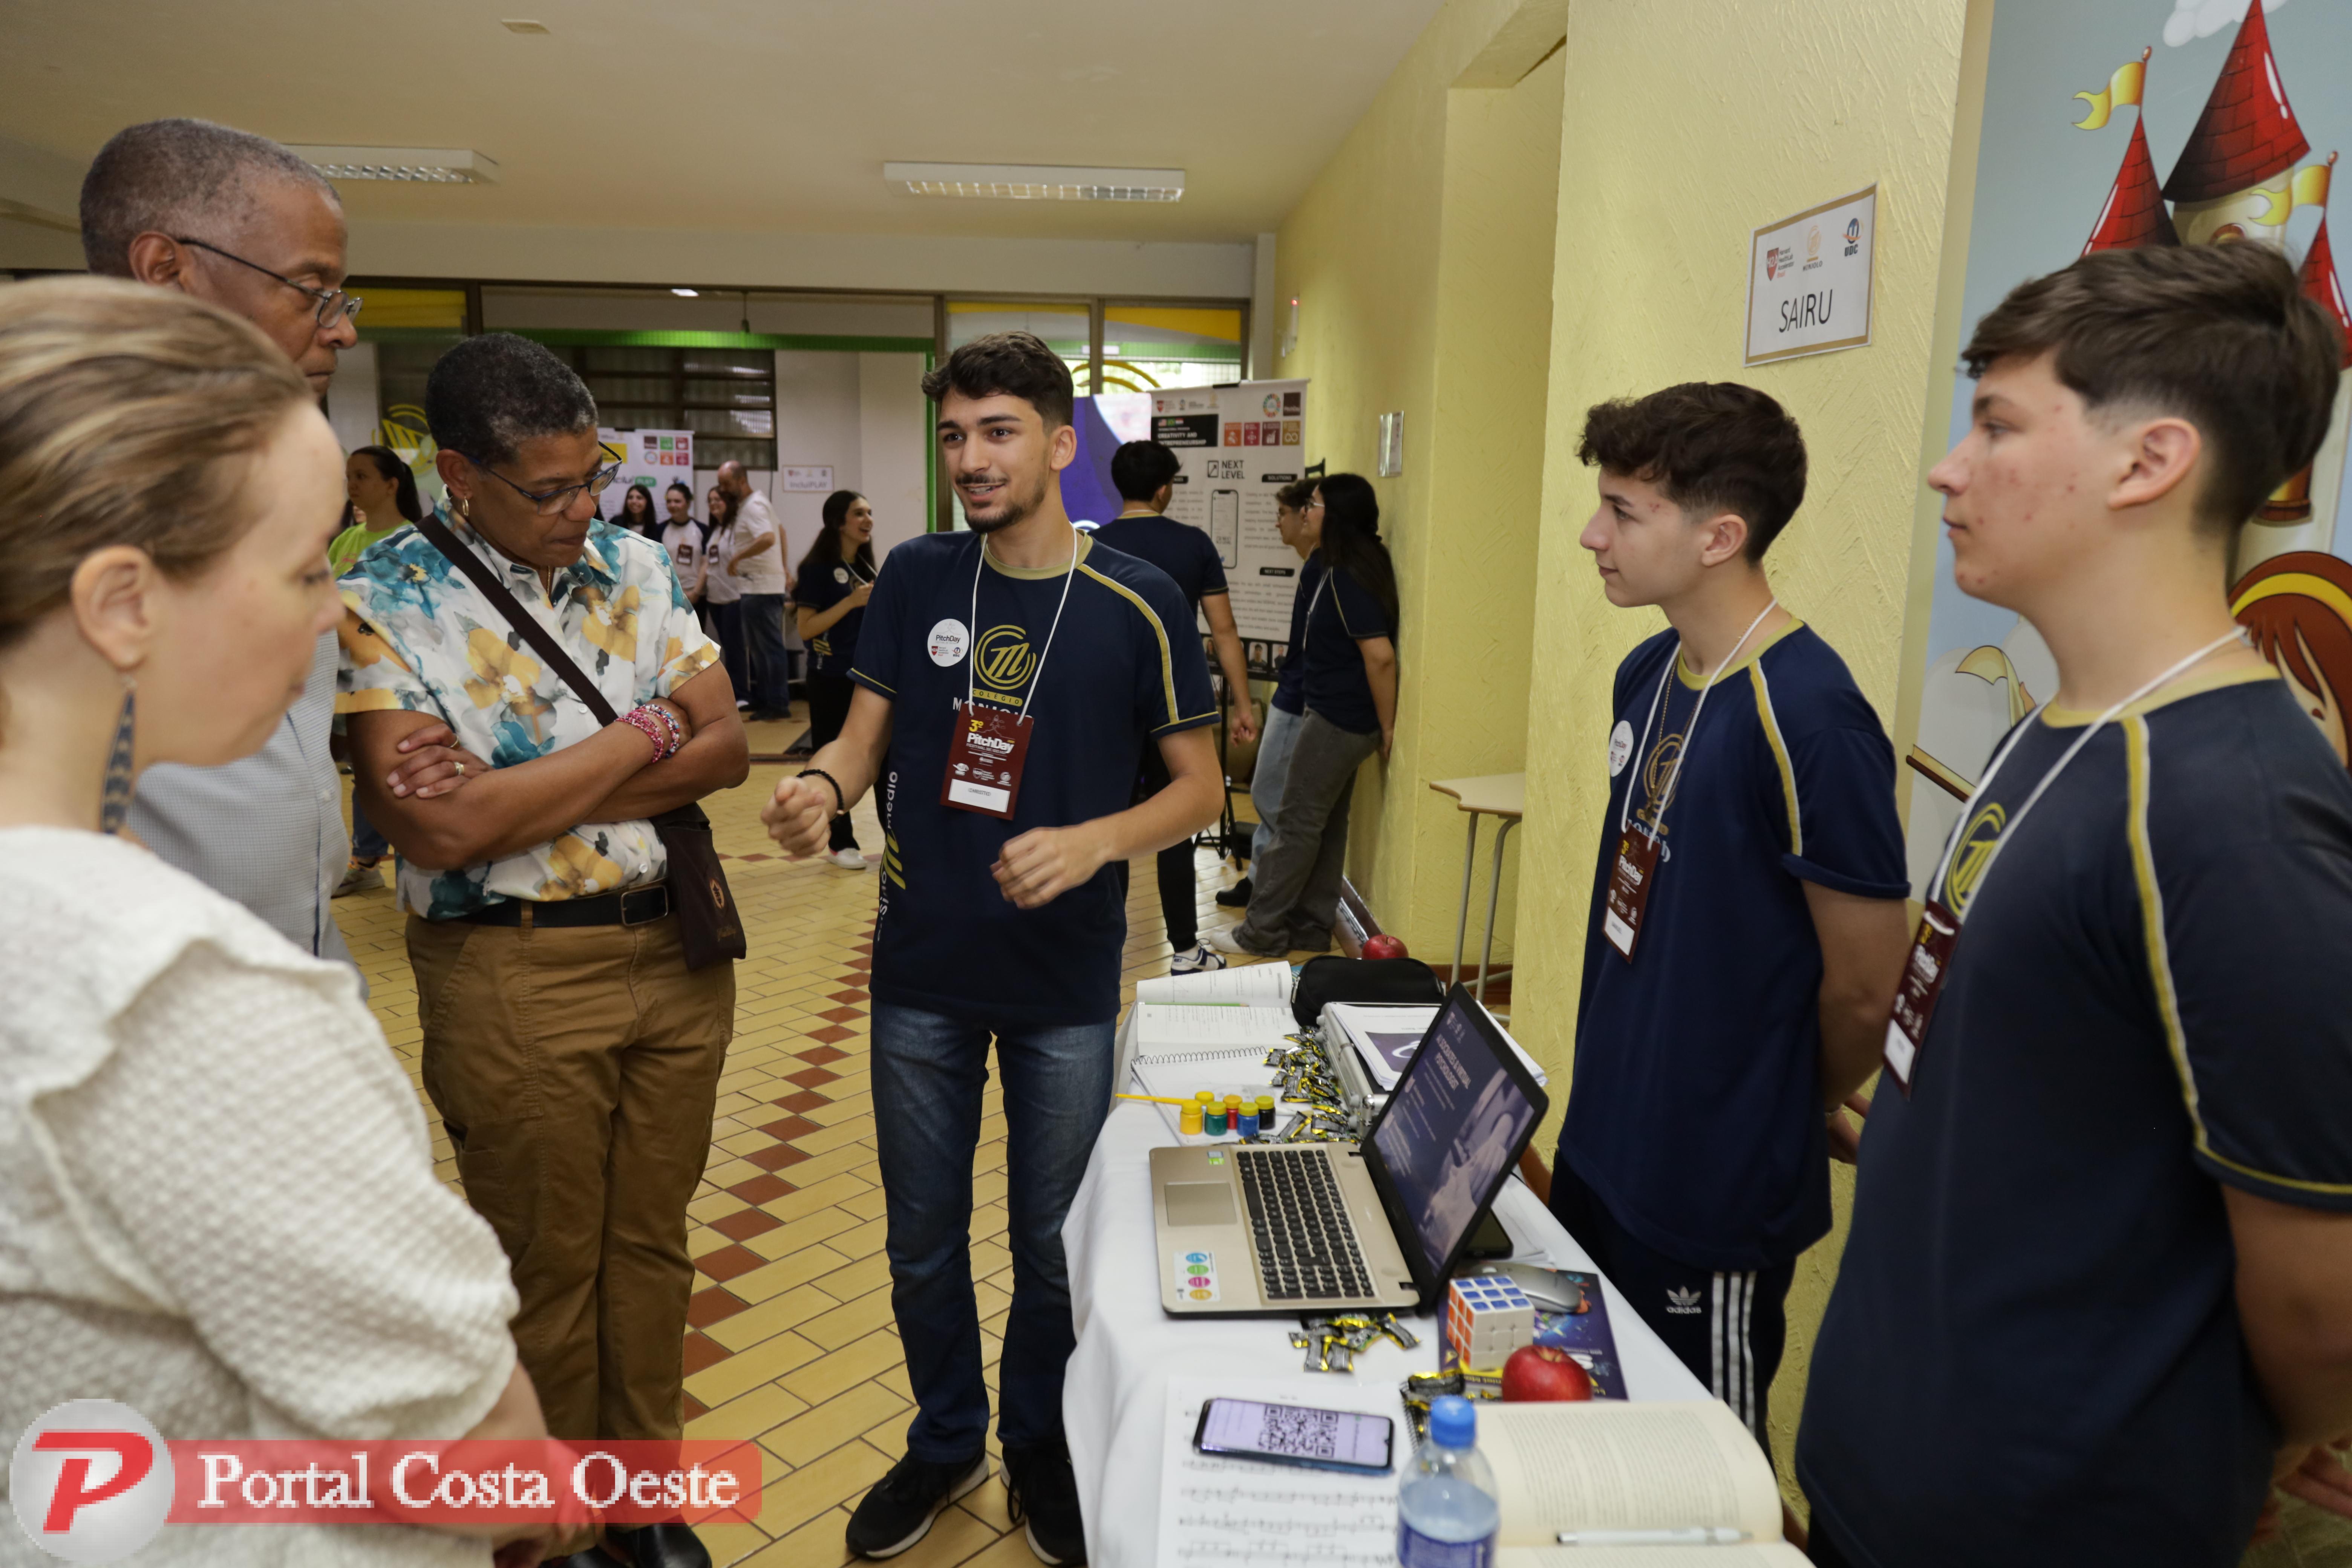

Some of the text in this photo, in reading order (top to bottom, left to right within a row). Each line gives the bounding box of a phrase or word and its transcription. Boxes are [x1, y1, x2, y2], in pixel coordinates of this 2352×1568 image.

[1845, 244, 1858, 256] UDC
[1803, 260, 1823, 271] MONJOLO
[1779, 289, 1833, 333] SAIRU
[1222, 460, 1244, 469] NEXT
[1222, 471, 1245, 479] LEVEL
[936, 635, 960, 643] PitchDay
[972, 690, 1019, 704] COLÉGIO
[967, 732, 1014, 753] PitchDay
[1619, 854, 1643, 886] PitchDay
